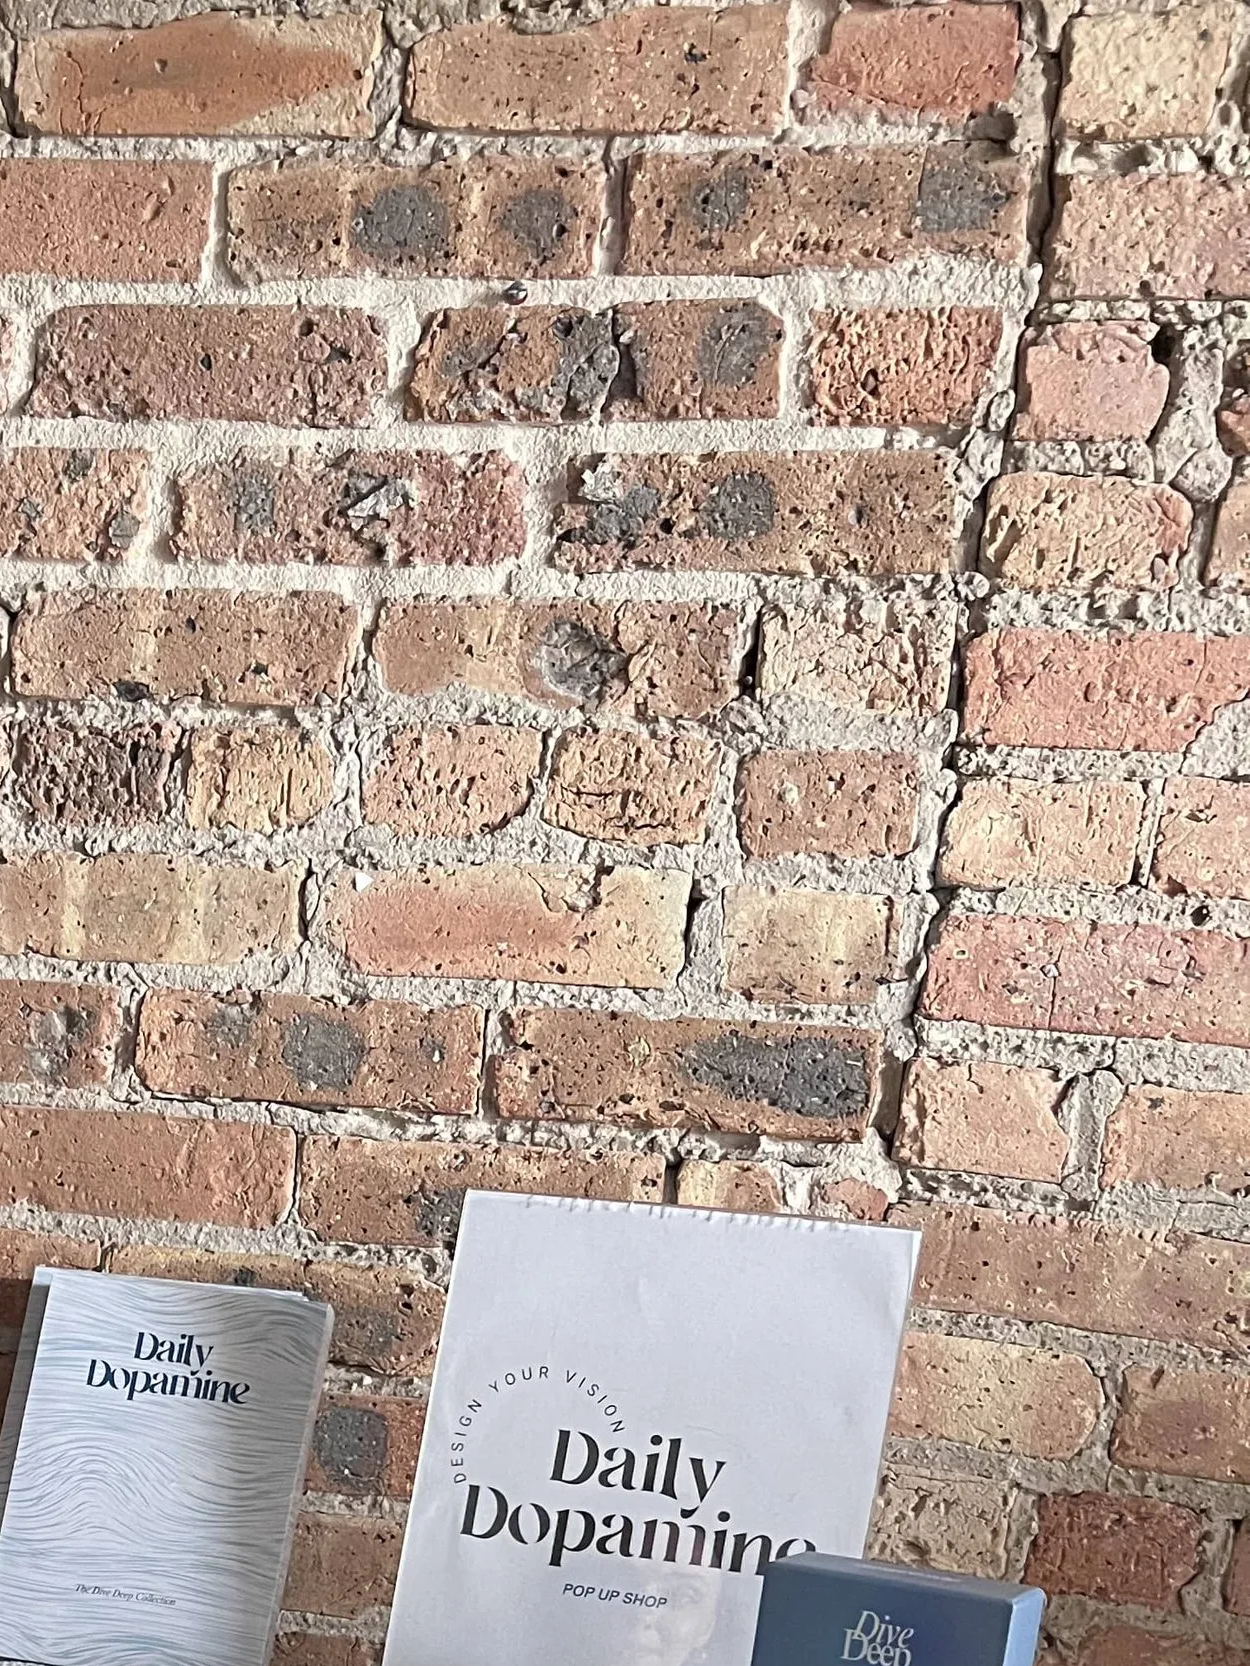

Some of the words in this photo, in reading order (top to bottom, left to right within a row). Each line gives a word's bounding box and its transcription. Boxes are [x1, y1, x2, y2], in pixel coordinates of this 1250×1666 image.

[133, 1331, 214, 1376] Daily
[86, 1359, 250, 1405] Dopamine
[450, 1399, 483, 1484] DESIGN
[488, 1366, 549, 1393] YOUR
[566, 1369, 625, 1433] VISION
[550, 1429, 726, 1518] Daily
[562, 1582, 595, 1599] POP
[598, 1590, 620, 1603] UP
[622, 1592, 668, 1609] SHOP
[852, 1610, 915, 1648] Dive
